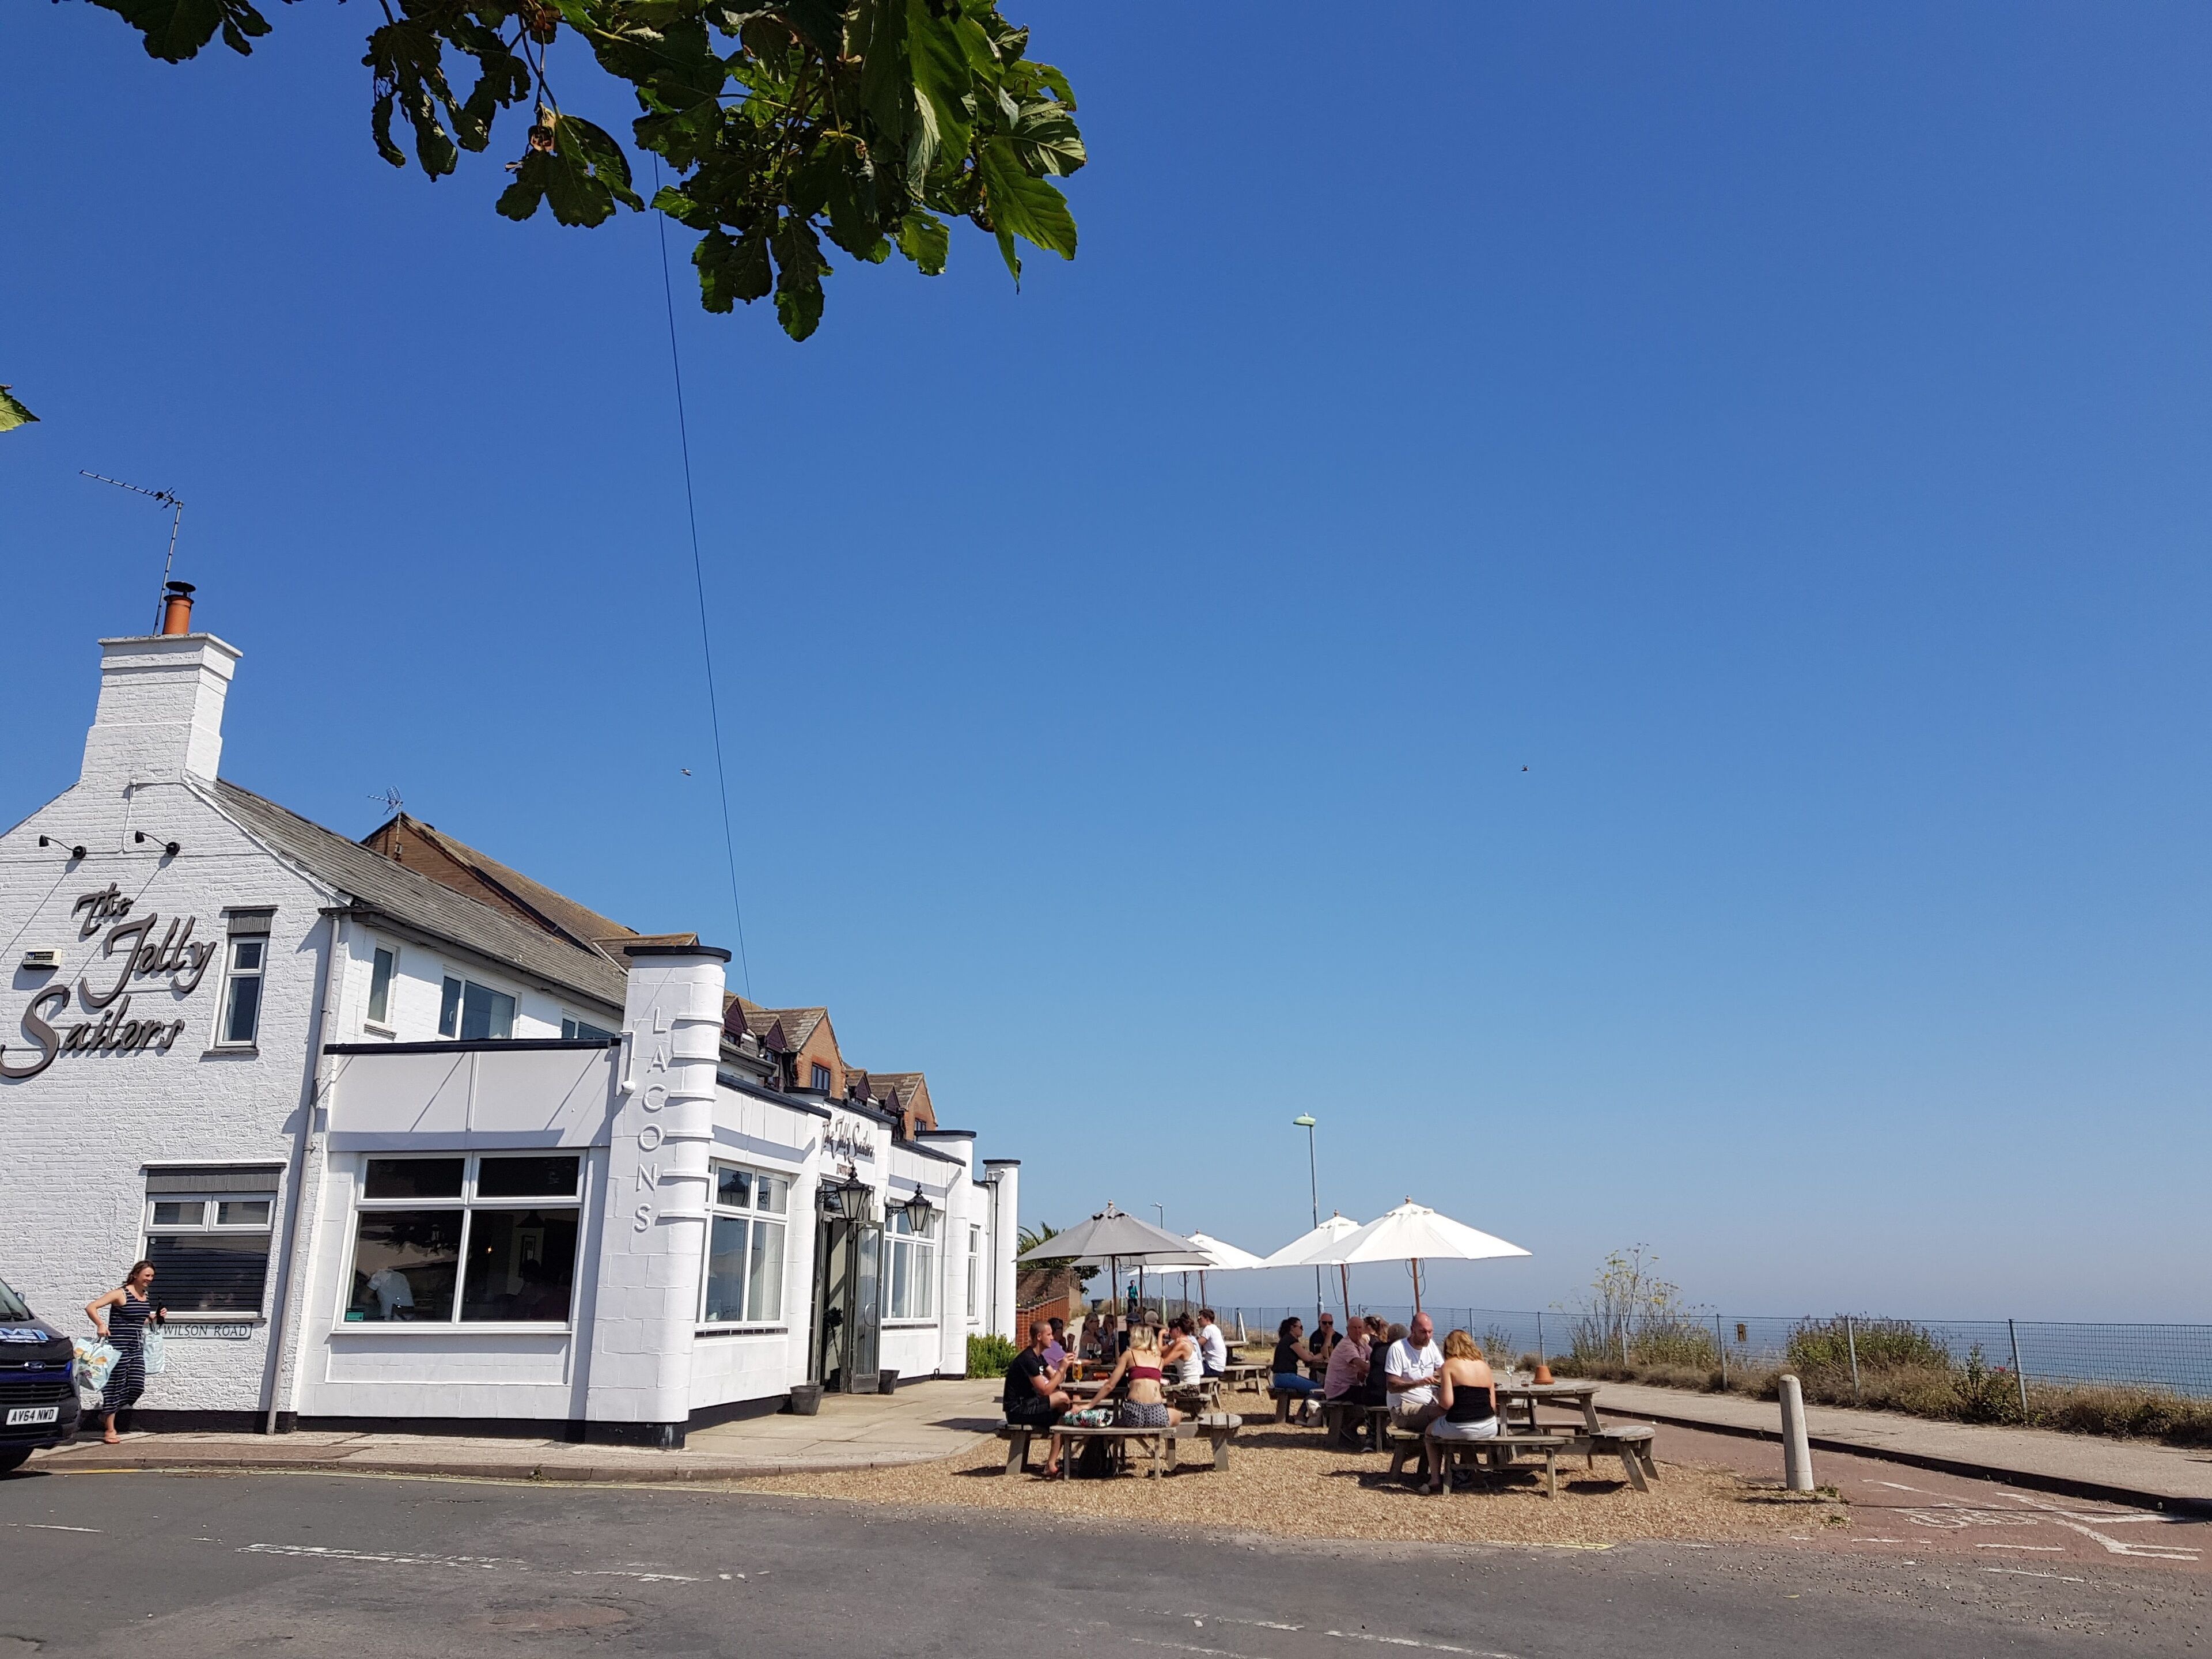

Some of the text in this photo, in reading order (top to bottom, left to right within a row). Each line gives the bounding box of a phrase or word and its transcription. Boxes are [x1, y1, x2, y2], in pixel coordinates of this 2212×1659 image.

[75, 881, 134, 935] The
[80, 912, 217, 1008] Jolly
[0, 984, 185, 1078] Sailors
[634, 1007, 668, 1233] LACONS
[164, 1325, 247, 1336] WILSON ROAD
[11, 1409, 54, 1422] AV64 NWD
